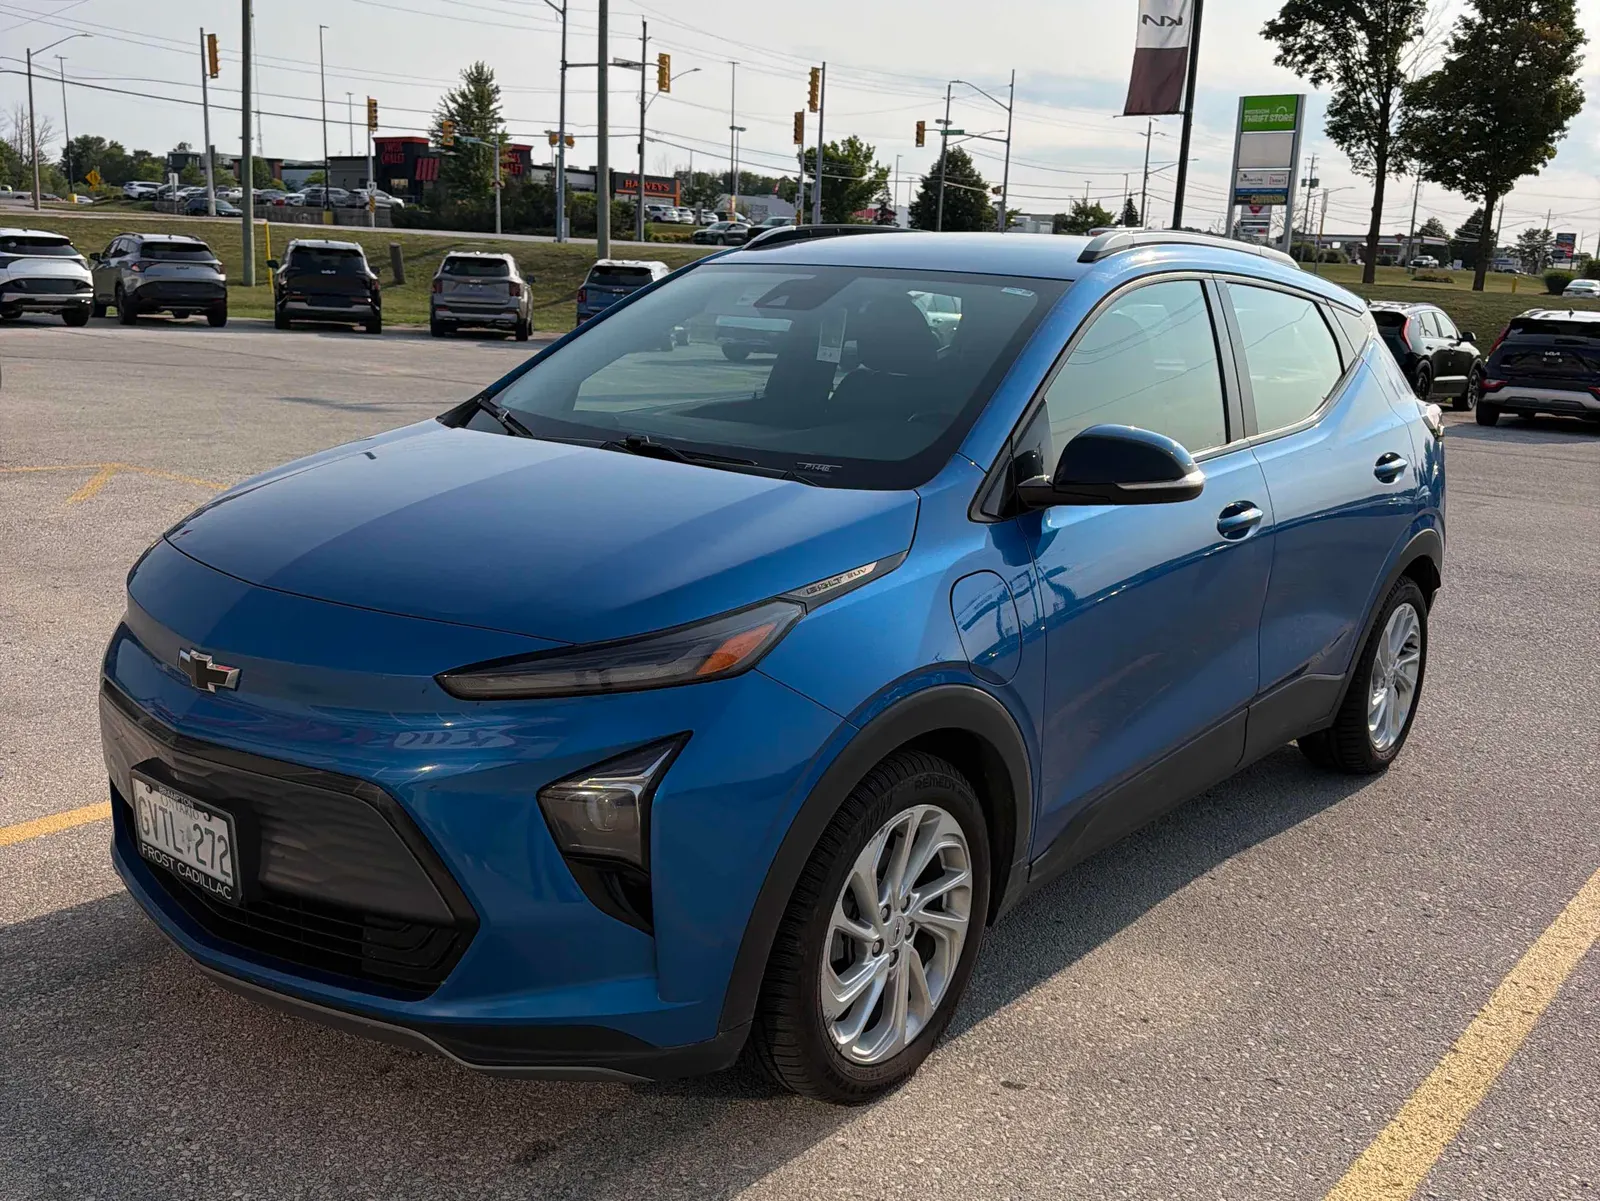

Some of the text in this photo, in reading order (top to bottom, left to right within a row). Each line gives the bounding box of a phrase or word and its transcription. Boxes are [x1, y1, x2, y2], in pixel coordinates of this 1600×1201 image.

[1243, 113, 1295, 123] THRIFT STORE
[806, 576, 844, 595] BOLT
[193, 823, 232, 878] 272
[141, 843, 232, 900] FROST CADILLAC
